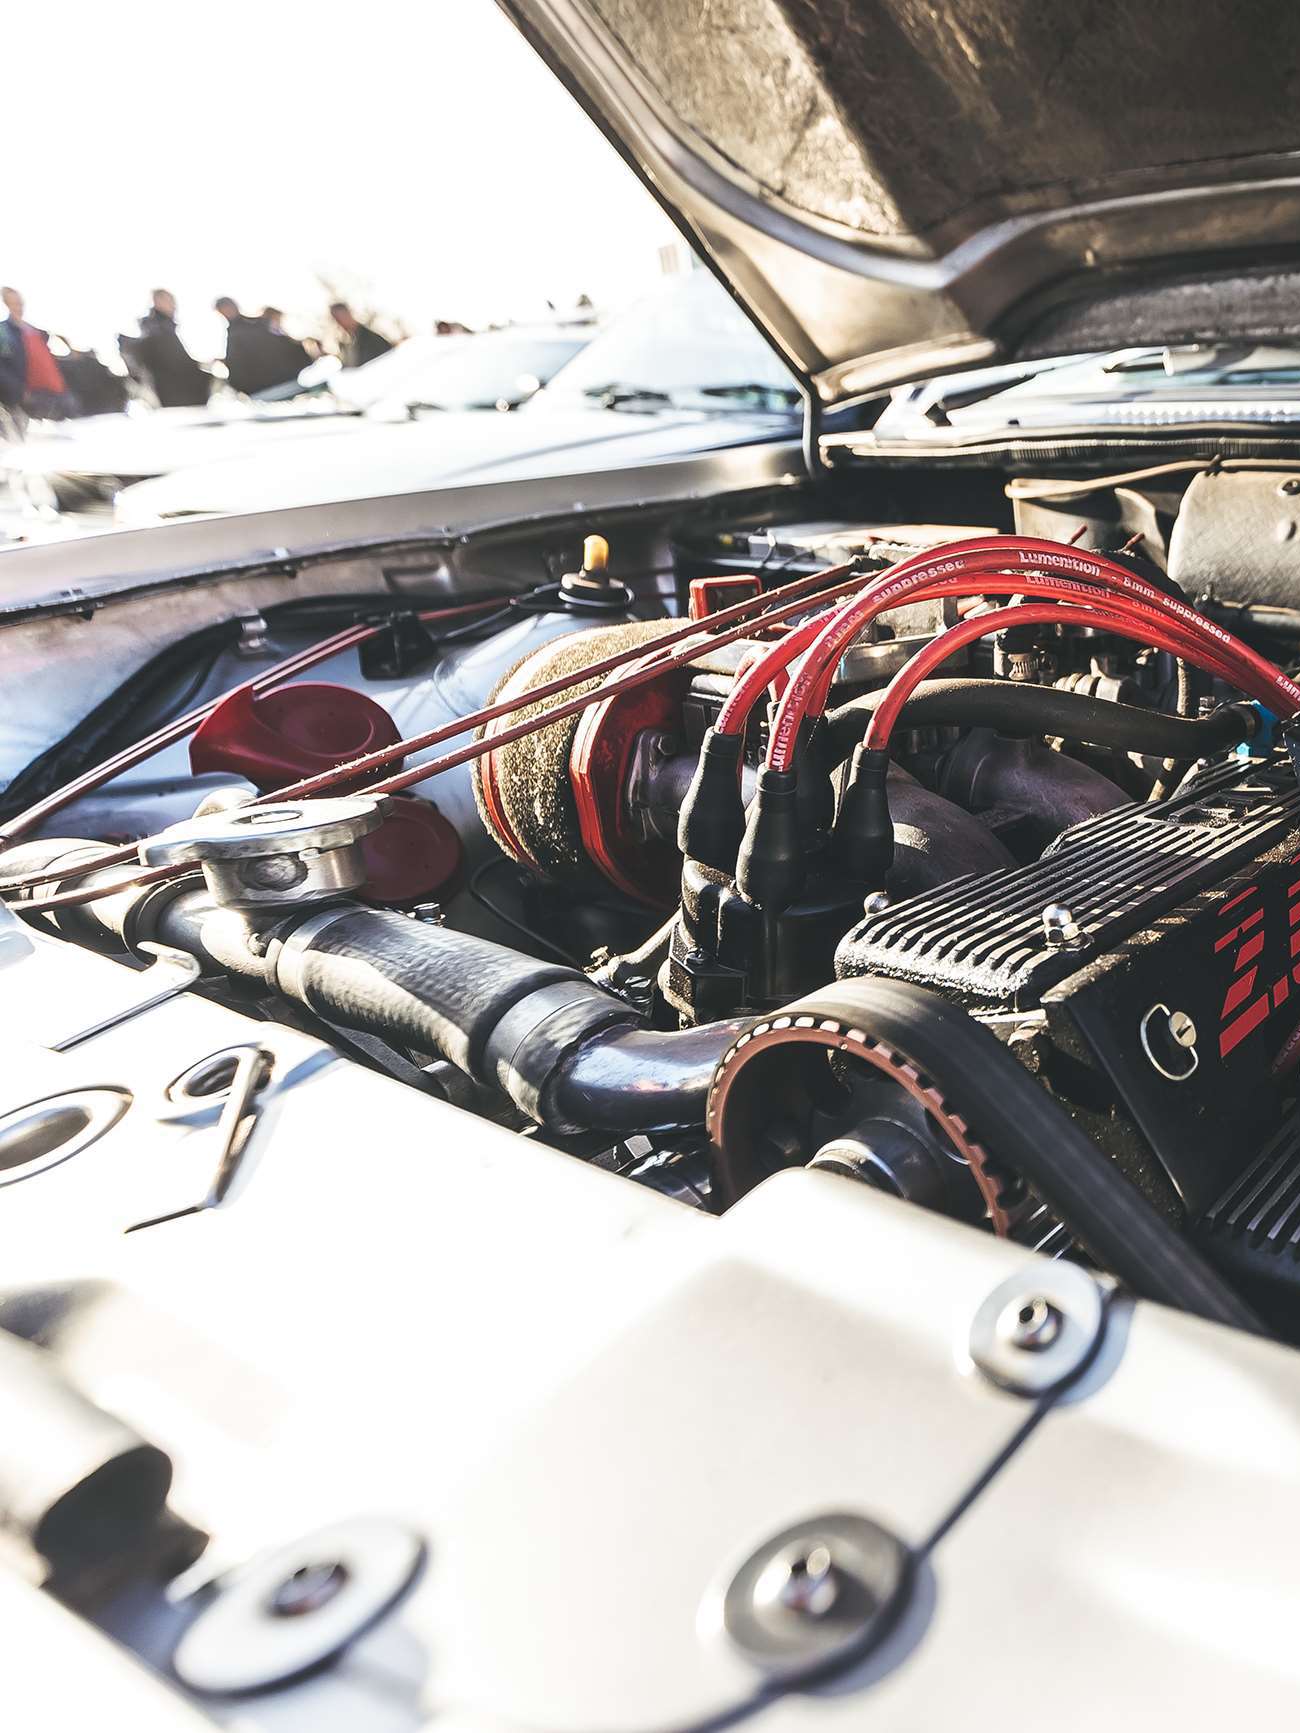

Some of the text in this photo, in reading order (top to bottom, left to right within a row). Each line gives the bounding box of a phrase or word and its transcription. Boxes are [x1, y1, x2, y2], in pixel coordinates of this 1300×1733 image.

[1018, 551, 1101, 576] Lumenition
[1123, 576, 1156, 599] 8mm
[1162, 597, 1231, 644] suppressed
